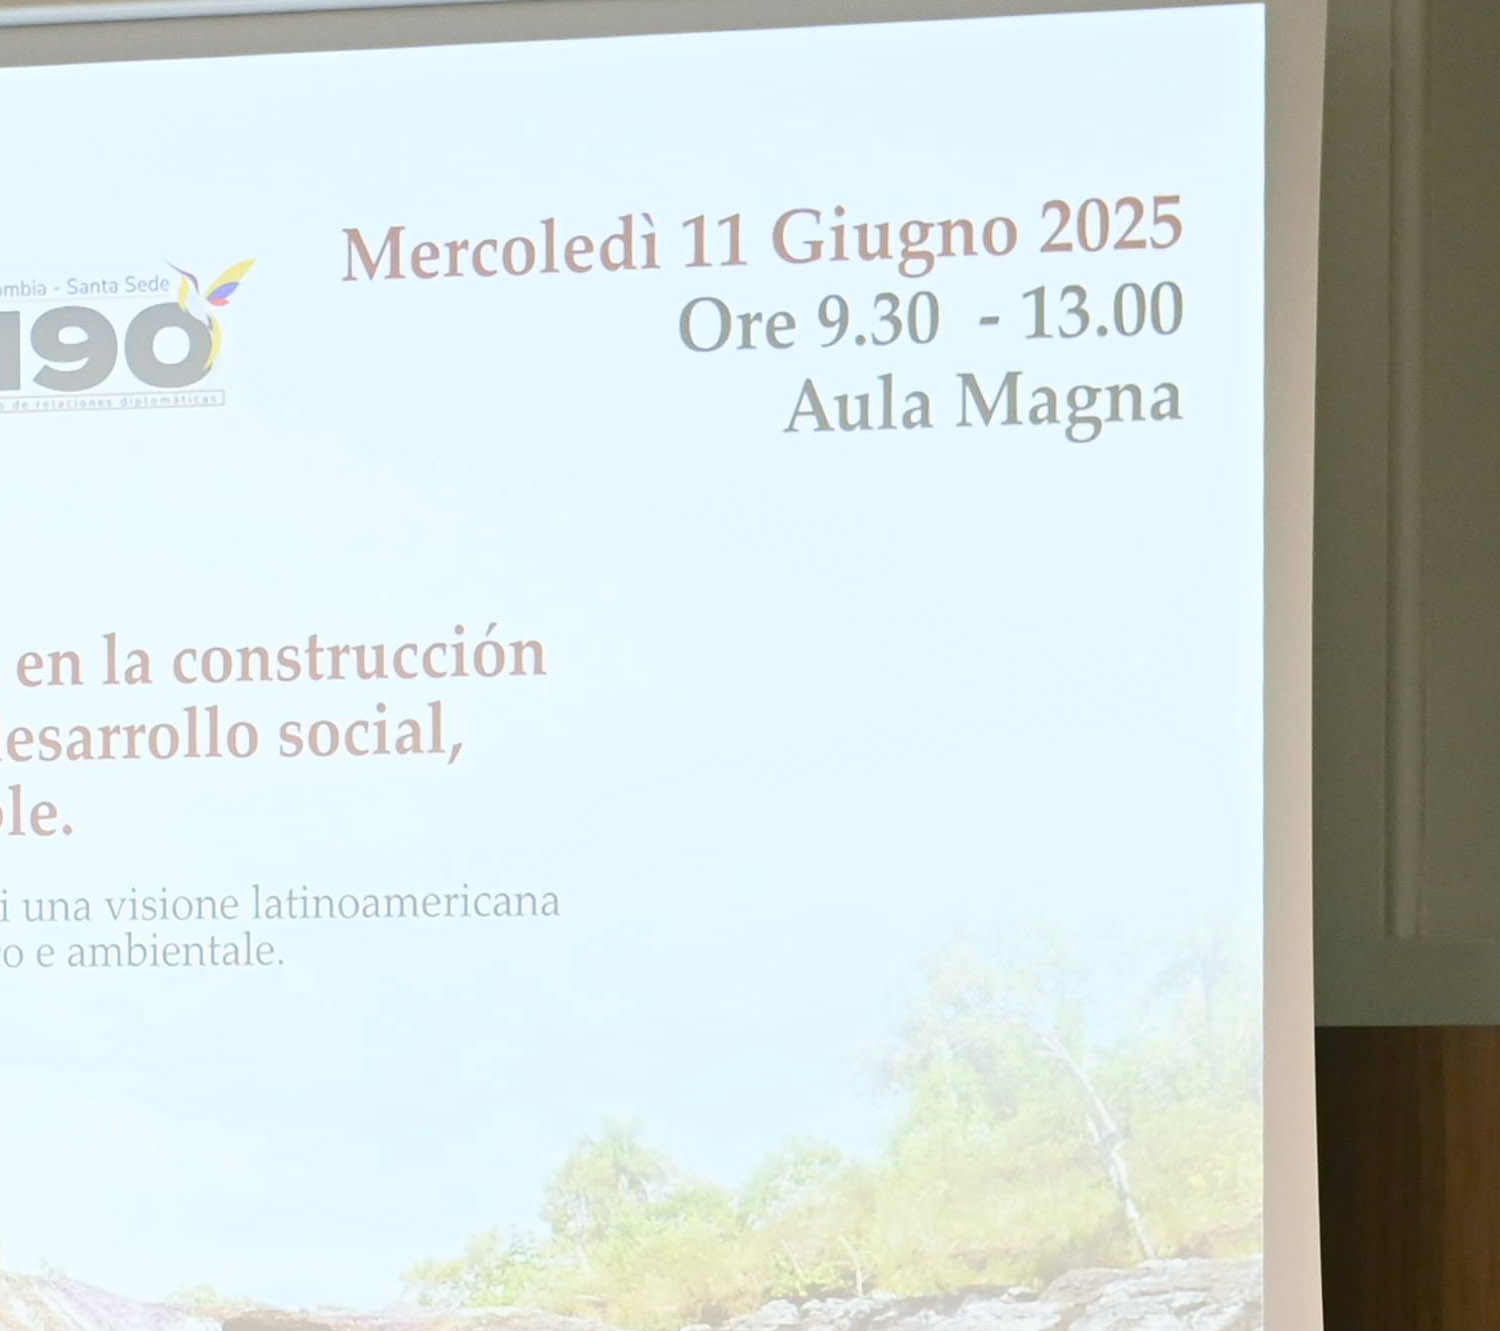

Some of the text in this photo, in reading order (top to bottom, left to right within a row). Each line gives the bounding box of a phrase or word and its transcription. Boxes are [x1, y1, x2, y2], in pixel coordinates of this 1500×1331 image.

[342, 195, 1182, 281] Mercoledì 11 Giugno 2025
[67, 278, 118, 295] Santa
[125, 275, 170, 293] Sede
[679, 297, 796, 352] Ore
[818, 291, 939, 347] 9.30
[1022, 281, 1183, 339] 13.00
[783, 371, 1183, 443] Aula Magna
[17, 651, 83, 687] en
[102, 632, 152, 685] la
[173, 622, 546, 684] construcción
[280, 700, 462, 765] social,
[23, 898, 90, 922] una
[105, 887, 238, 921] visione
[252, 883, 559, 919] latinoamericana
[37, 944, 54, 967] e
[68, 931, 283, 967] ambientale.
